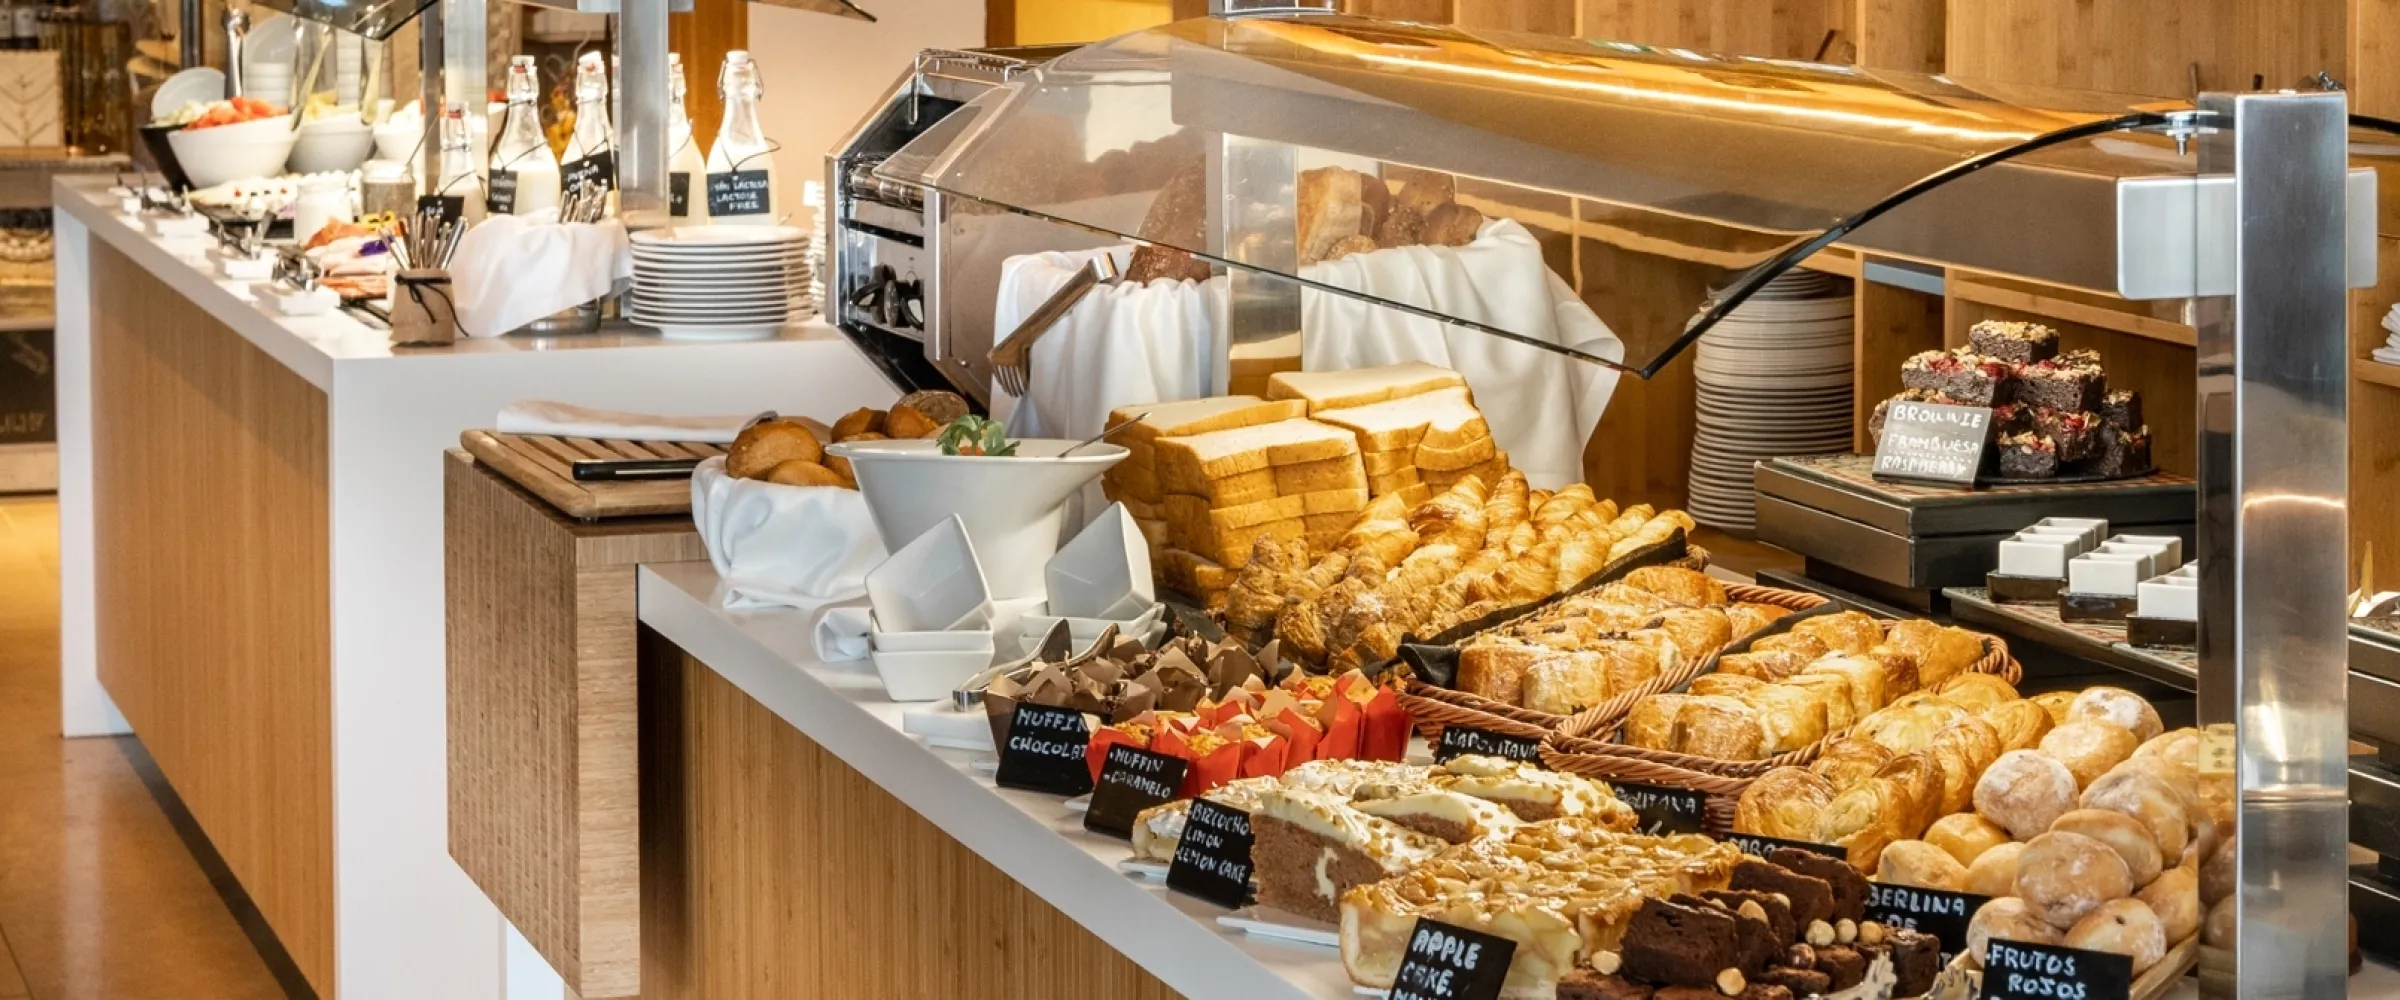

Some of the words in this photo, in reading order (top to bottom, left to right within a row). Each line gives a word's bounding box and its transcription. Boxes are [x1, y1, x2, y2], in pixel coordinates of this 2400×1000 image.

[716, 191, 758, 203] LACTOSE
[728, 201, 760, 211] FREE
[1893, 405, 1982, 428] BROWNIE
[1887, 433, 1979, 455] FRAMBUESA
[1881, 455, 1967, 477] RASPBERRY
[1016, 708, 1088, 733] MUFFIN
[1218, 859, 1247, 885] CAKE
[1865, 883, 1965, 915] BERLINA
[1412, 929, 1482, 970] APPLE
[2008, 973, 2087, 1000] ROJOS
